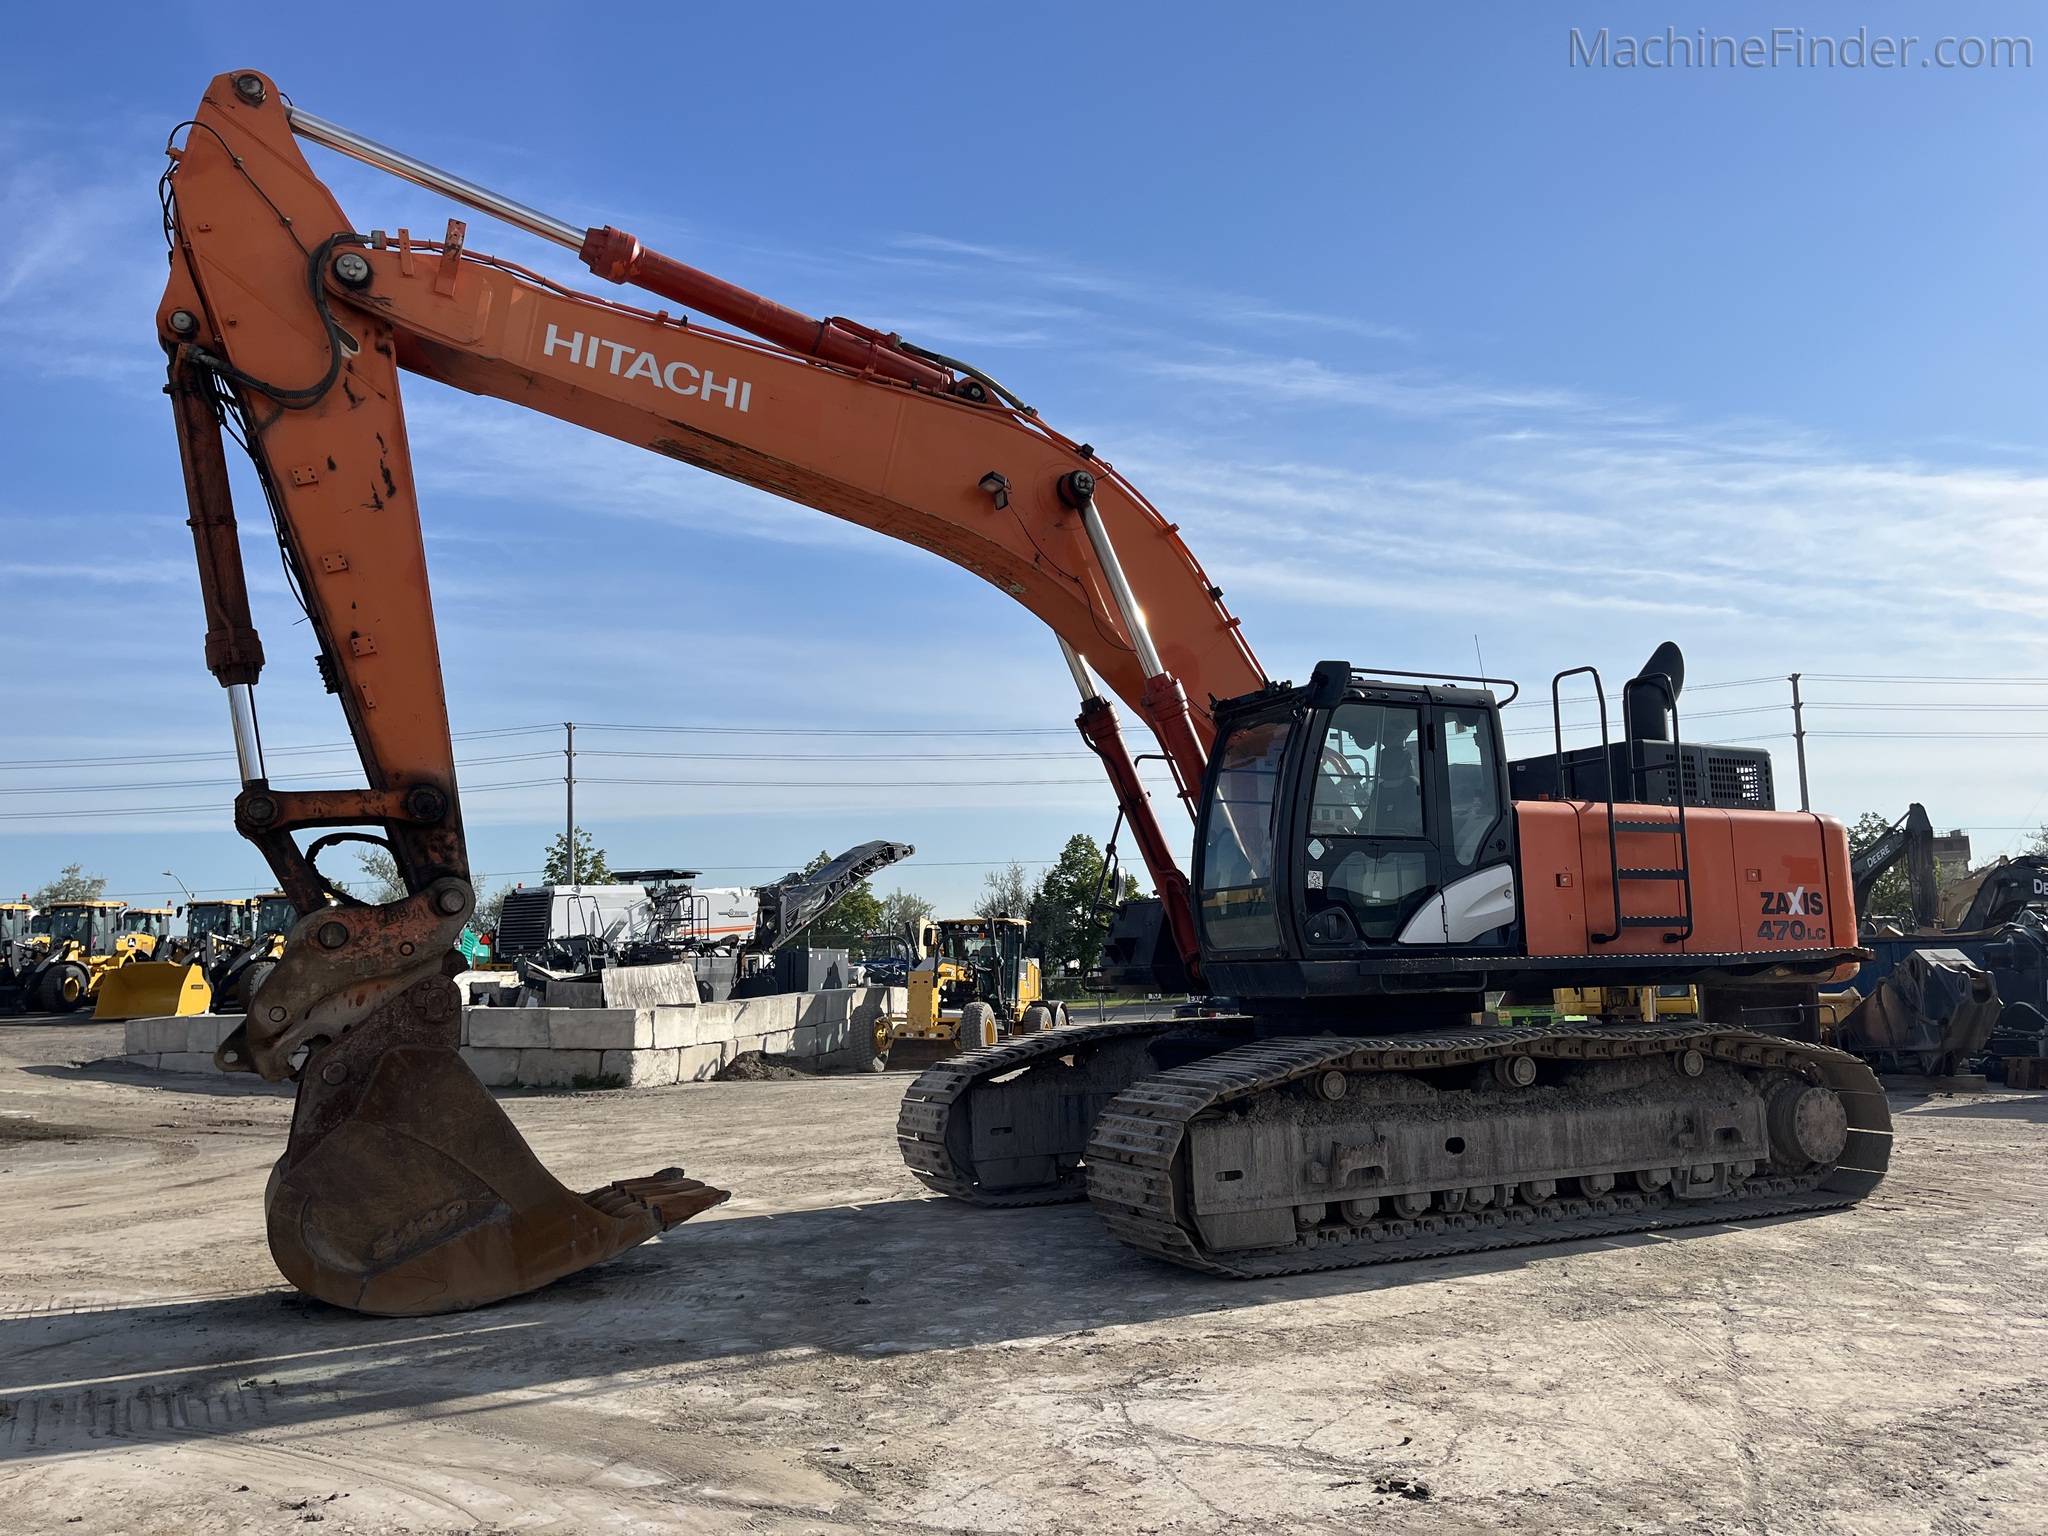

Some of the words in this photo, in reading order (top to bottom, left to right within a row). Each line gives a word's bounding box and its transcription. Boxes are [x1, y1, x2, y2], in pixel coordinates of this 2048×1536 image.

[543, 323, 752, 413] HITACHI
[1866, 844, 1890, 868] DEERE
[1760, 886, 1824, 915] ZAXIS
[1757, 920, 1806, 941] 470
[1807, 927, 1826, 940] LC
